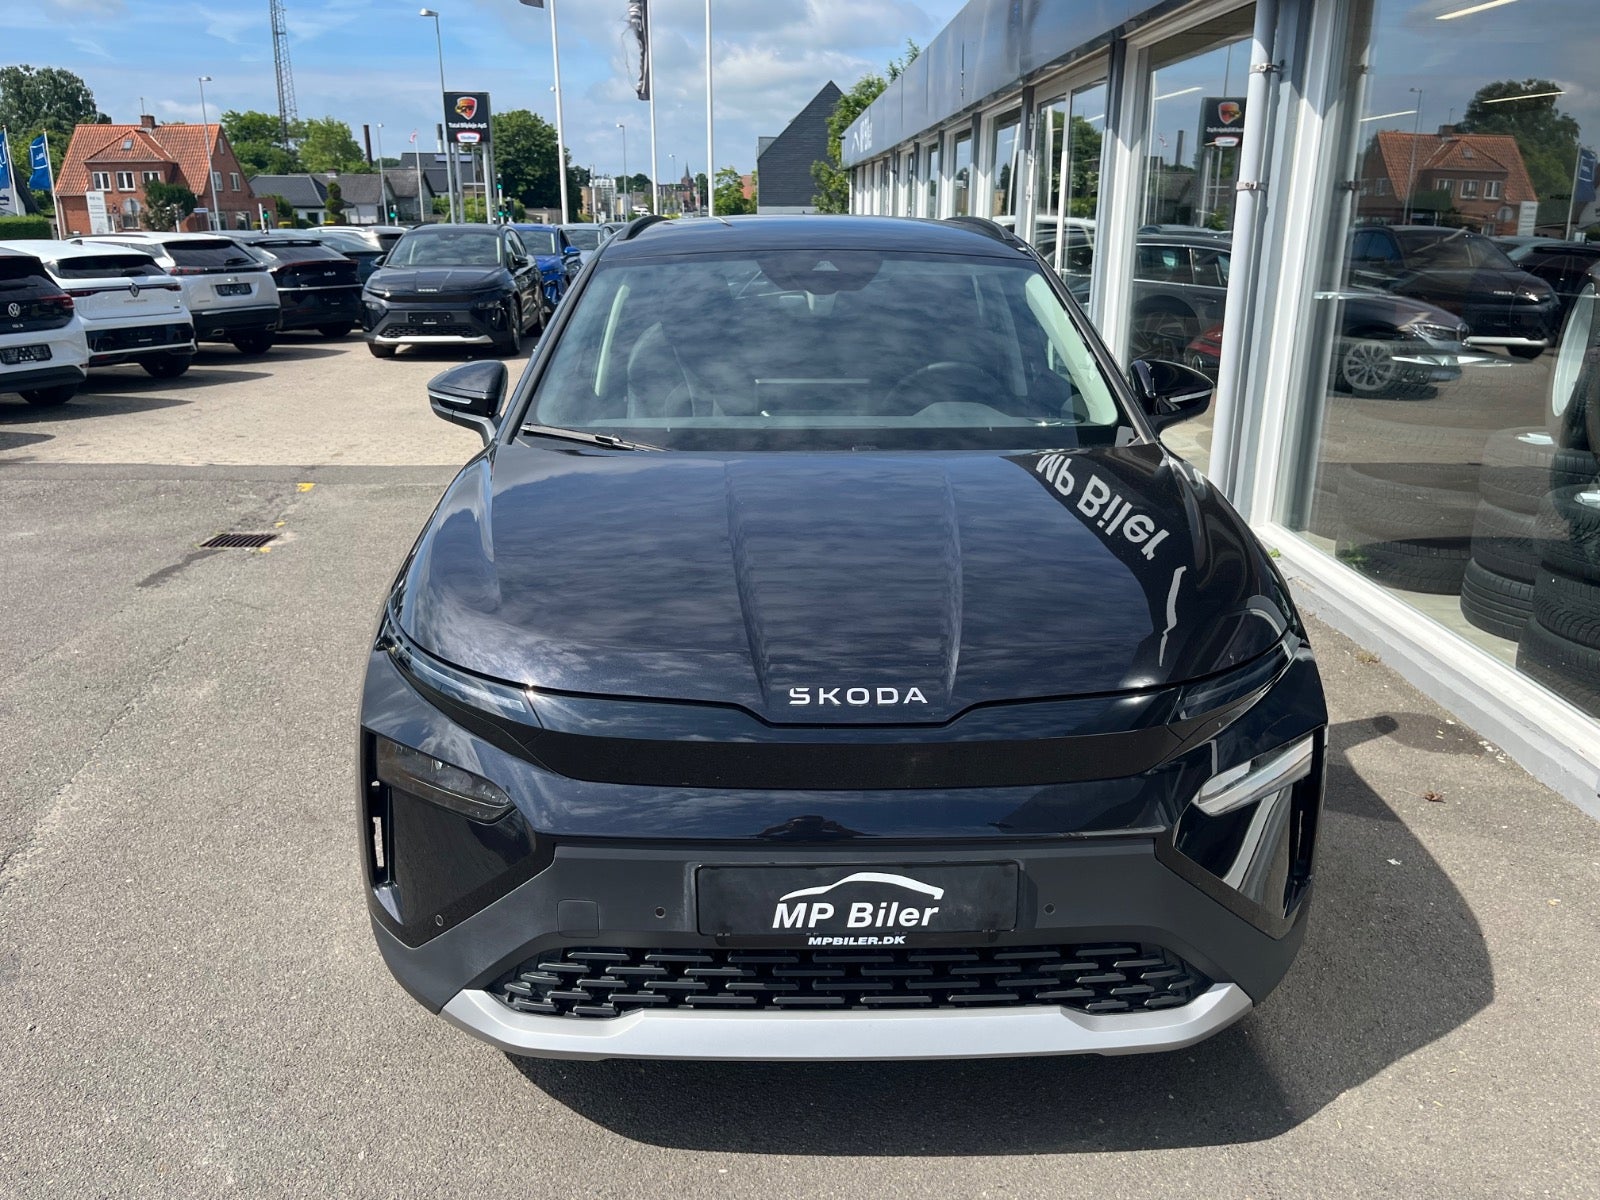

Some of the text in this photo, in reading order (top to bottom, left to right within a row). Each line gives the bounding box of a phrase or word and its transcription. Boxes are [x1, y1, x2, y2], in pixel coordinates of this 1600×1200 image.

[772, 901, 939, 929] MP Biler
[808, 935, 907, 946] MPBILER.DK
